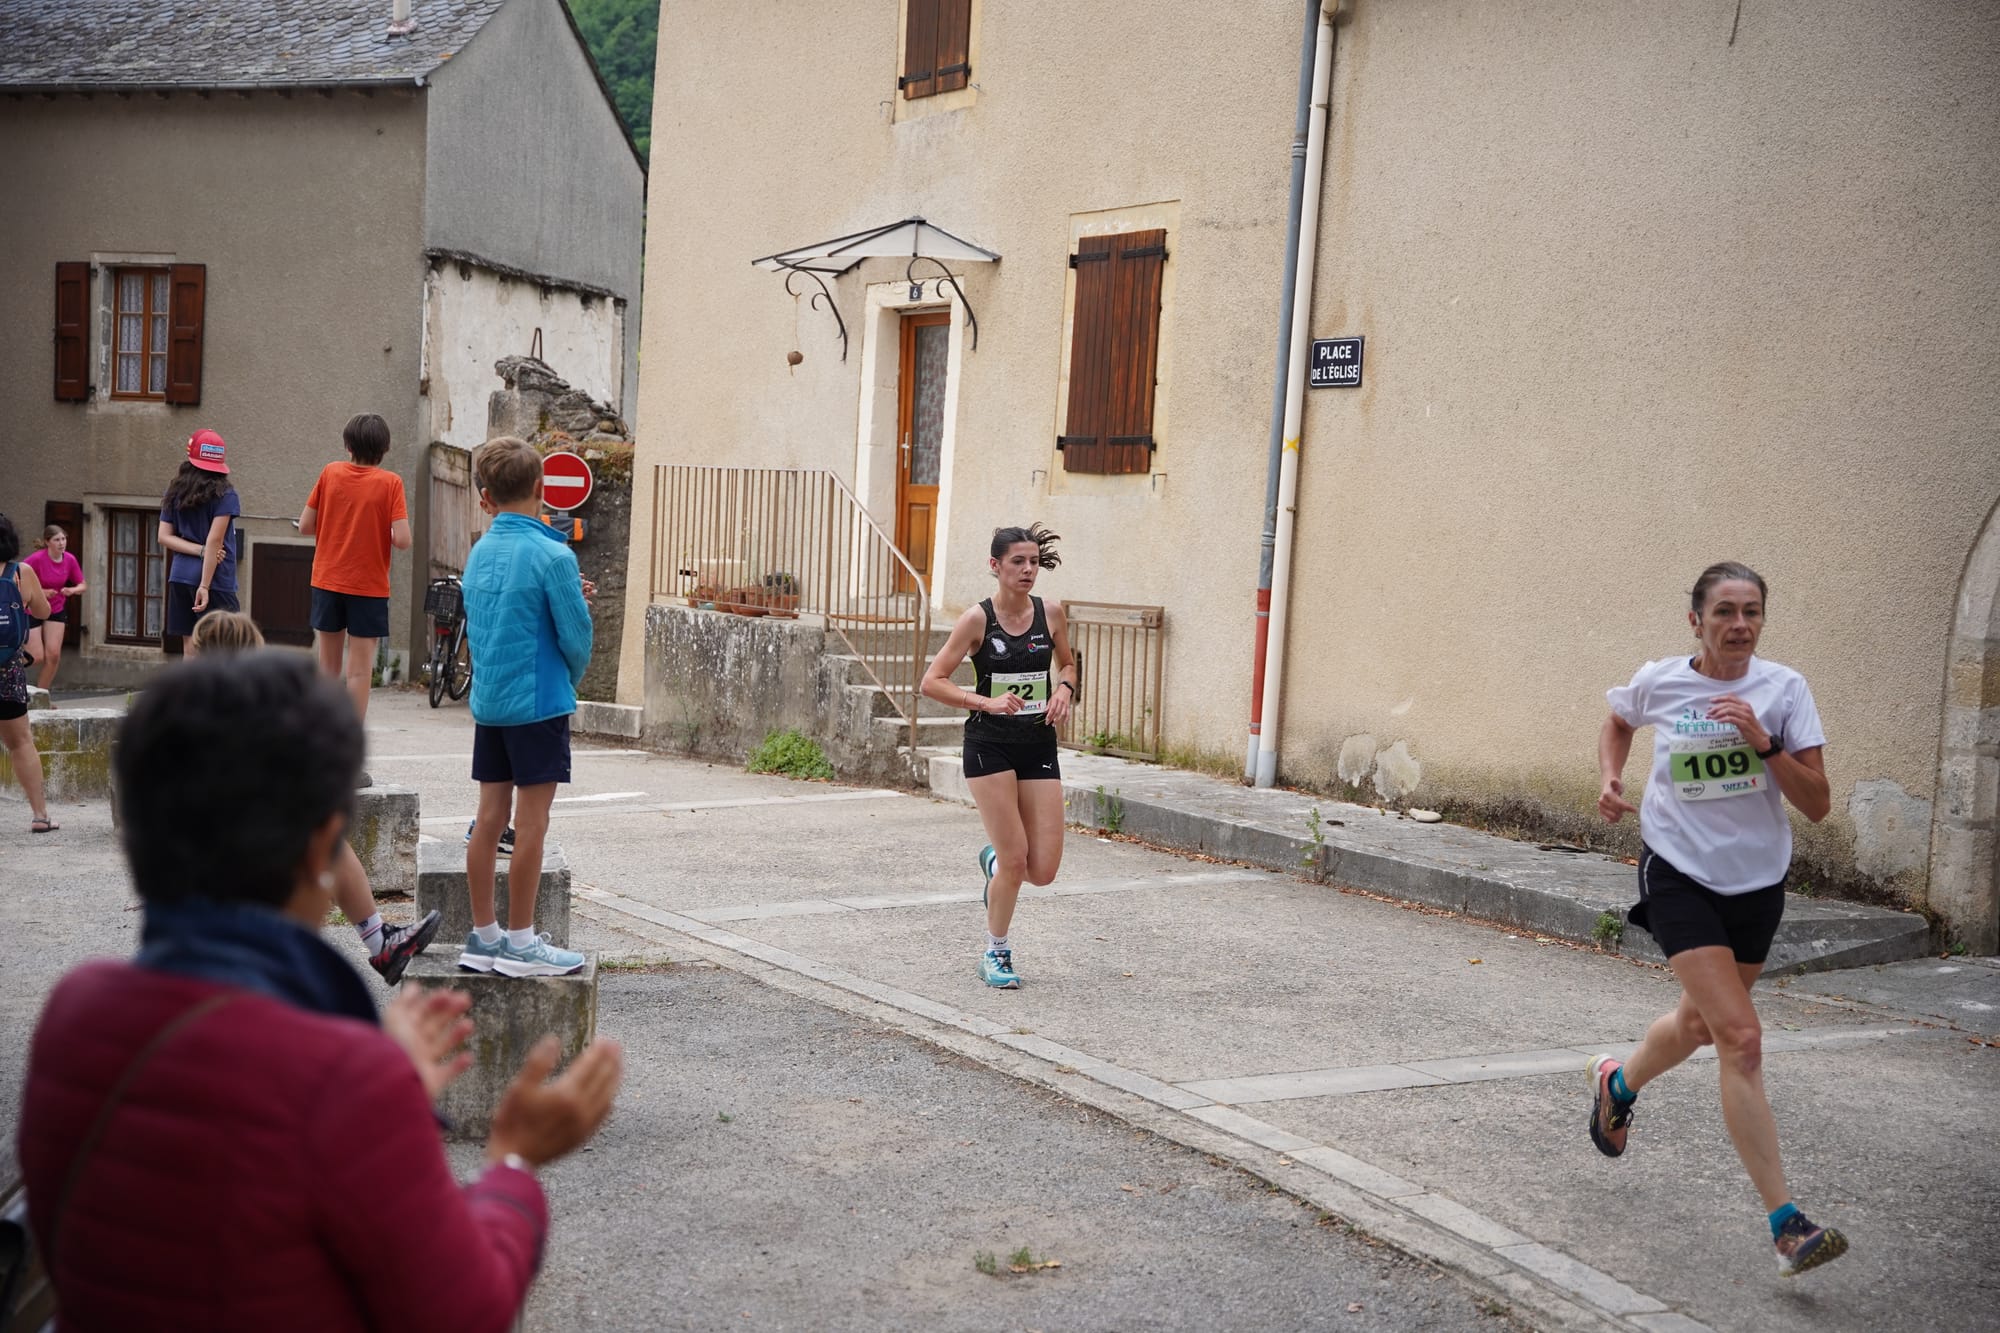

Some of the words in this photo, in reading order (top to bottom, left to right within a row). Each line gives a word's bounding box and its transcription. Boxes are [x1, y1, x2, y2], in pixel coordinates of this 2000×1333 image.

[912, 287, 919, 298] 6
[1320, 345, 1352, 360] PLACE
[1312, 368, 1321, 380] DE
[1322, 362, 1359, 379] L'ÉGLISE
[1007, 683, 1034, 700] 22
[1684, 751, 1750, 780] 109
